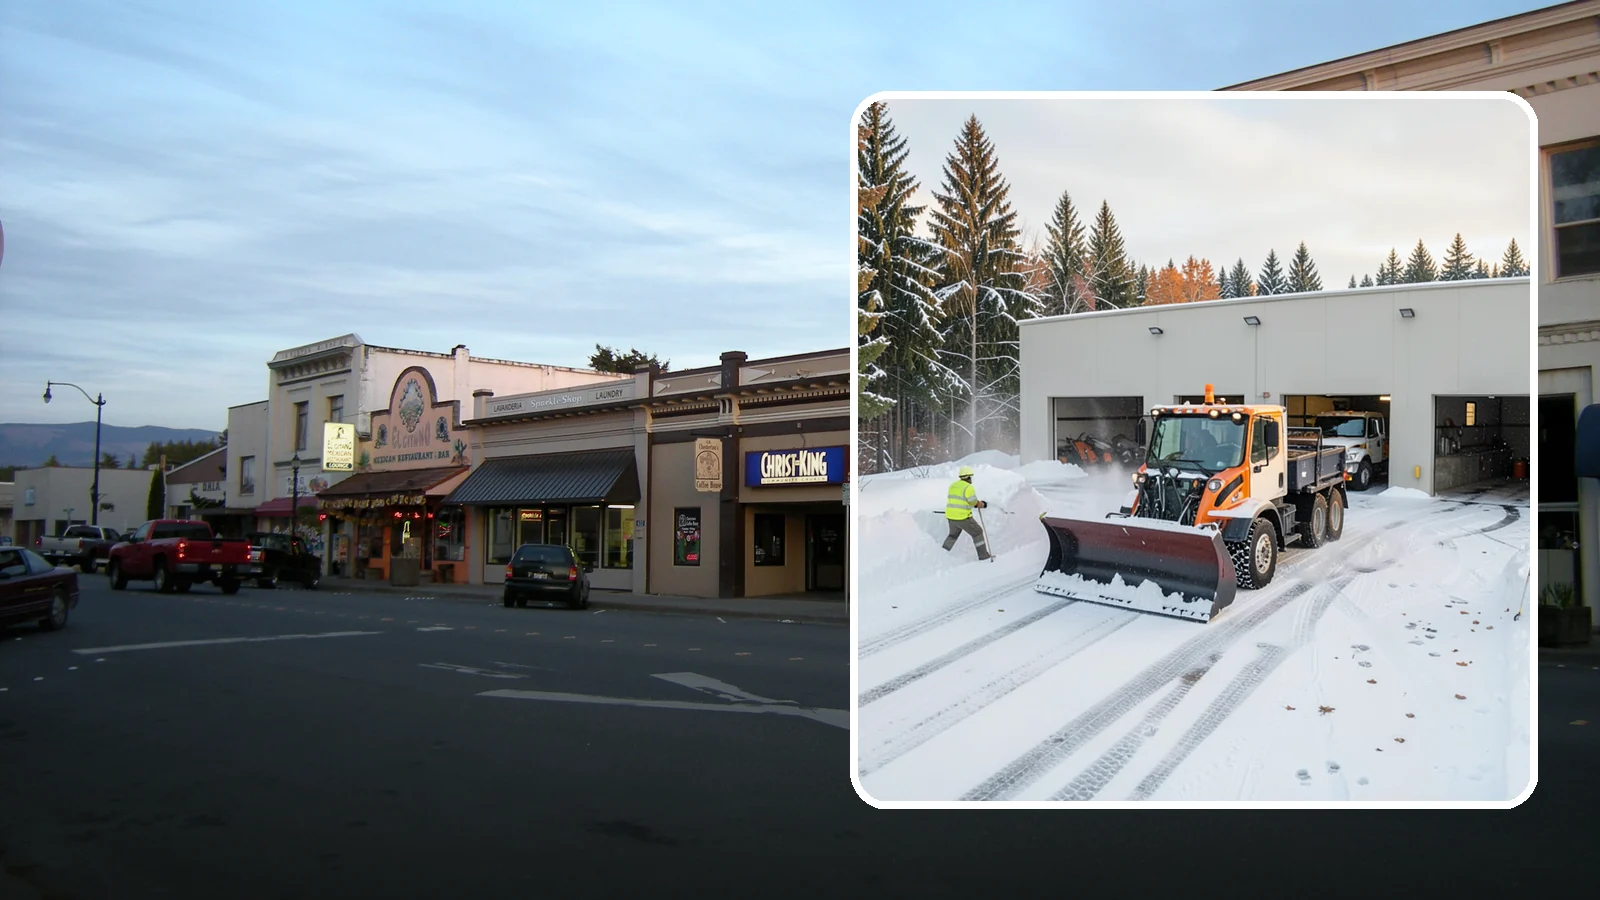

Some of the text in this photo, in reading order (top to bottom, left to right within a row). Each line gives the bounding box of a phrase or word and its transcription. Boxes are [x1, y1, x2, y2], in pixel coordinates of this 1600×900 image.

[595, 389, 623, 400] LAUNDRY
[494, 403, 523, 412] LAVANDERIA
[531, 395, 583, 409] Sparkle Shop
[398, 452, 433, 462] RESTAURANT
[438, 450, 450, 459] BAR
[761, 450, 828, 478] CHRIST KING
